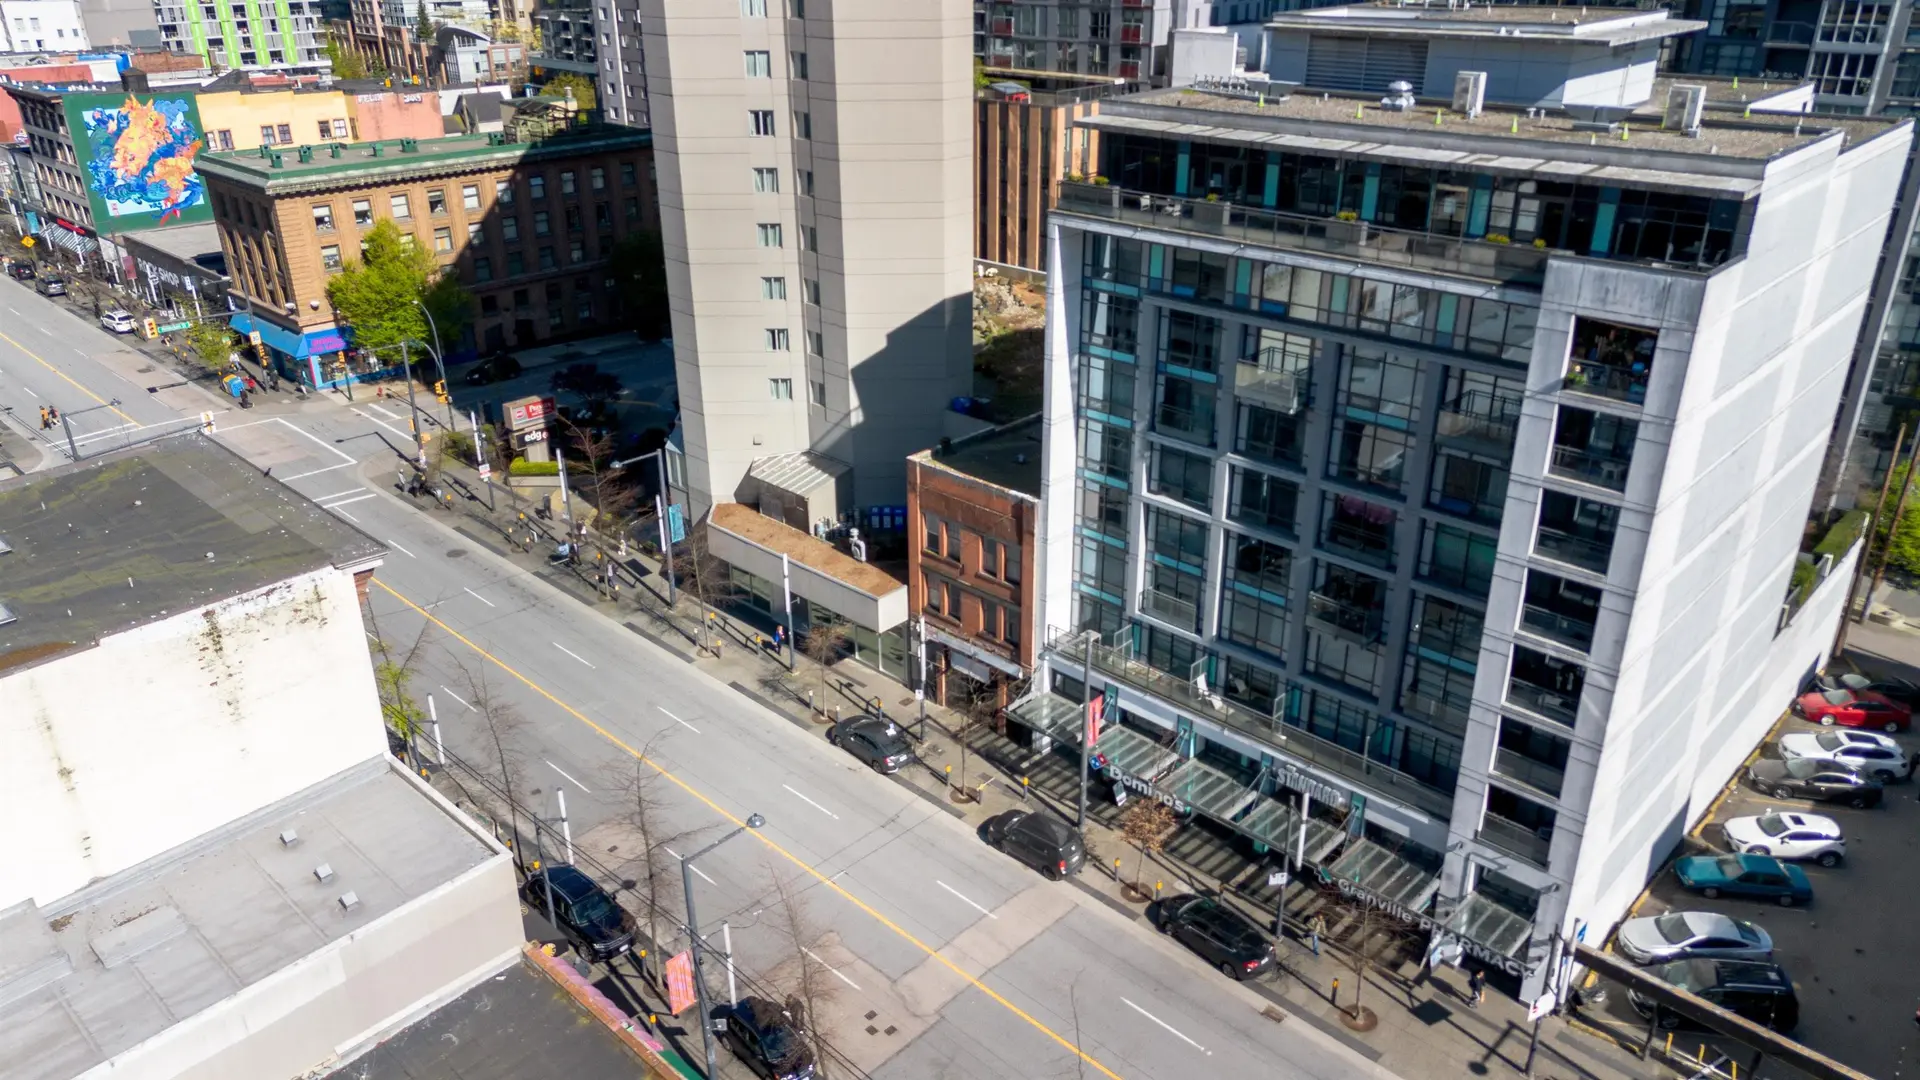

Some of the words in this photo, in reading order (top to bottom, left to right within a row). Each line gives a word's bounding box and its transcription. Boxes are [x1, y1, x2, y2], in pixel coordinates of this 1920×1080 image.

[158, 267, 179, 288] SHOP
[524, 430, 549, 442] edge
[1109, 764, 1184, 813] Domino's
[1338, 879, 1412, 923] Granville
[1420, 919, 1535, 979] PHARMACY
